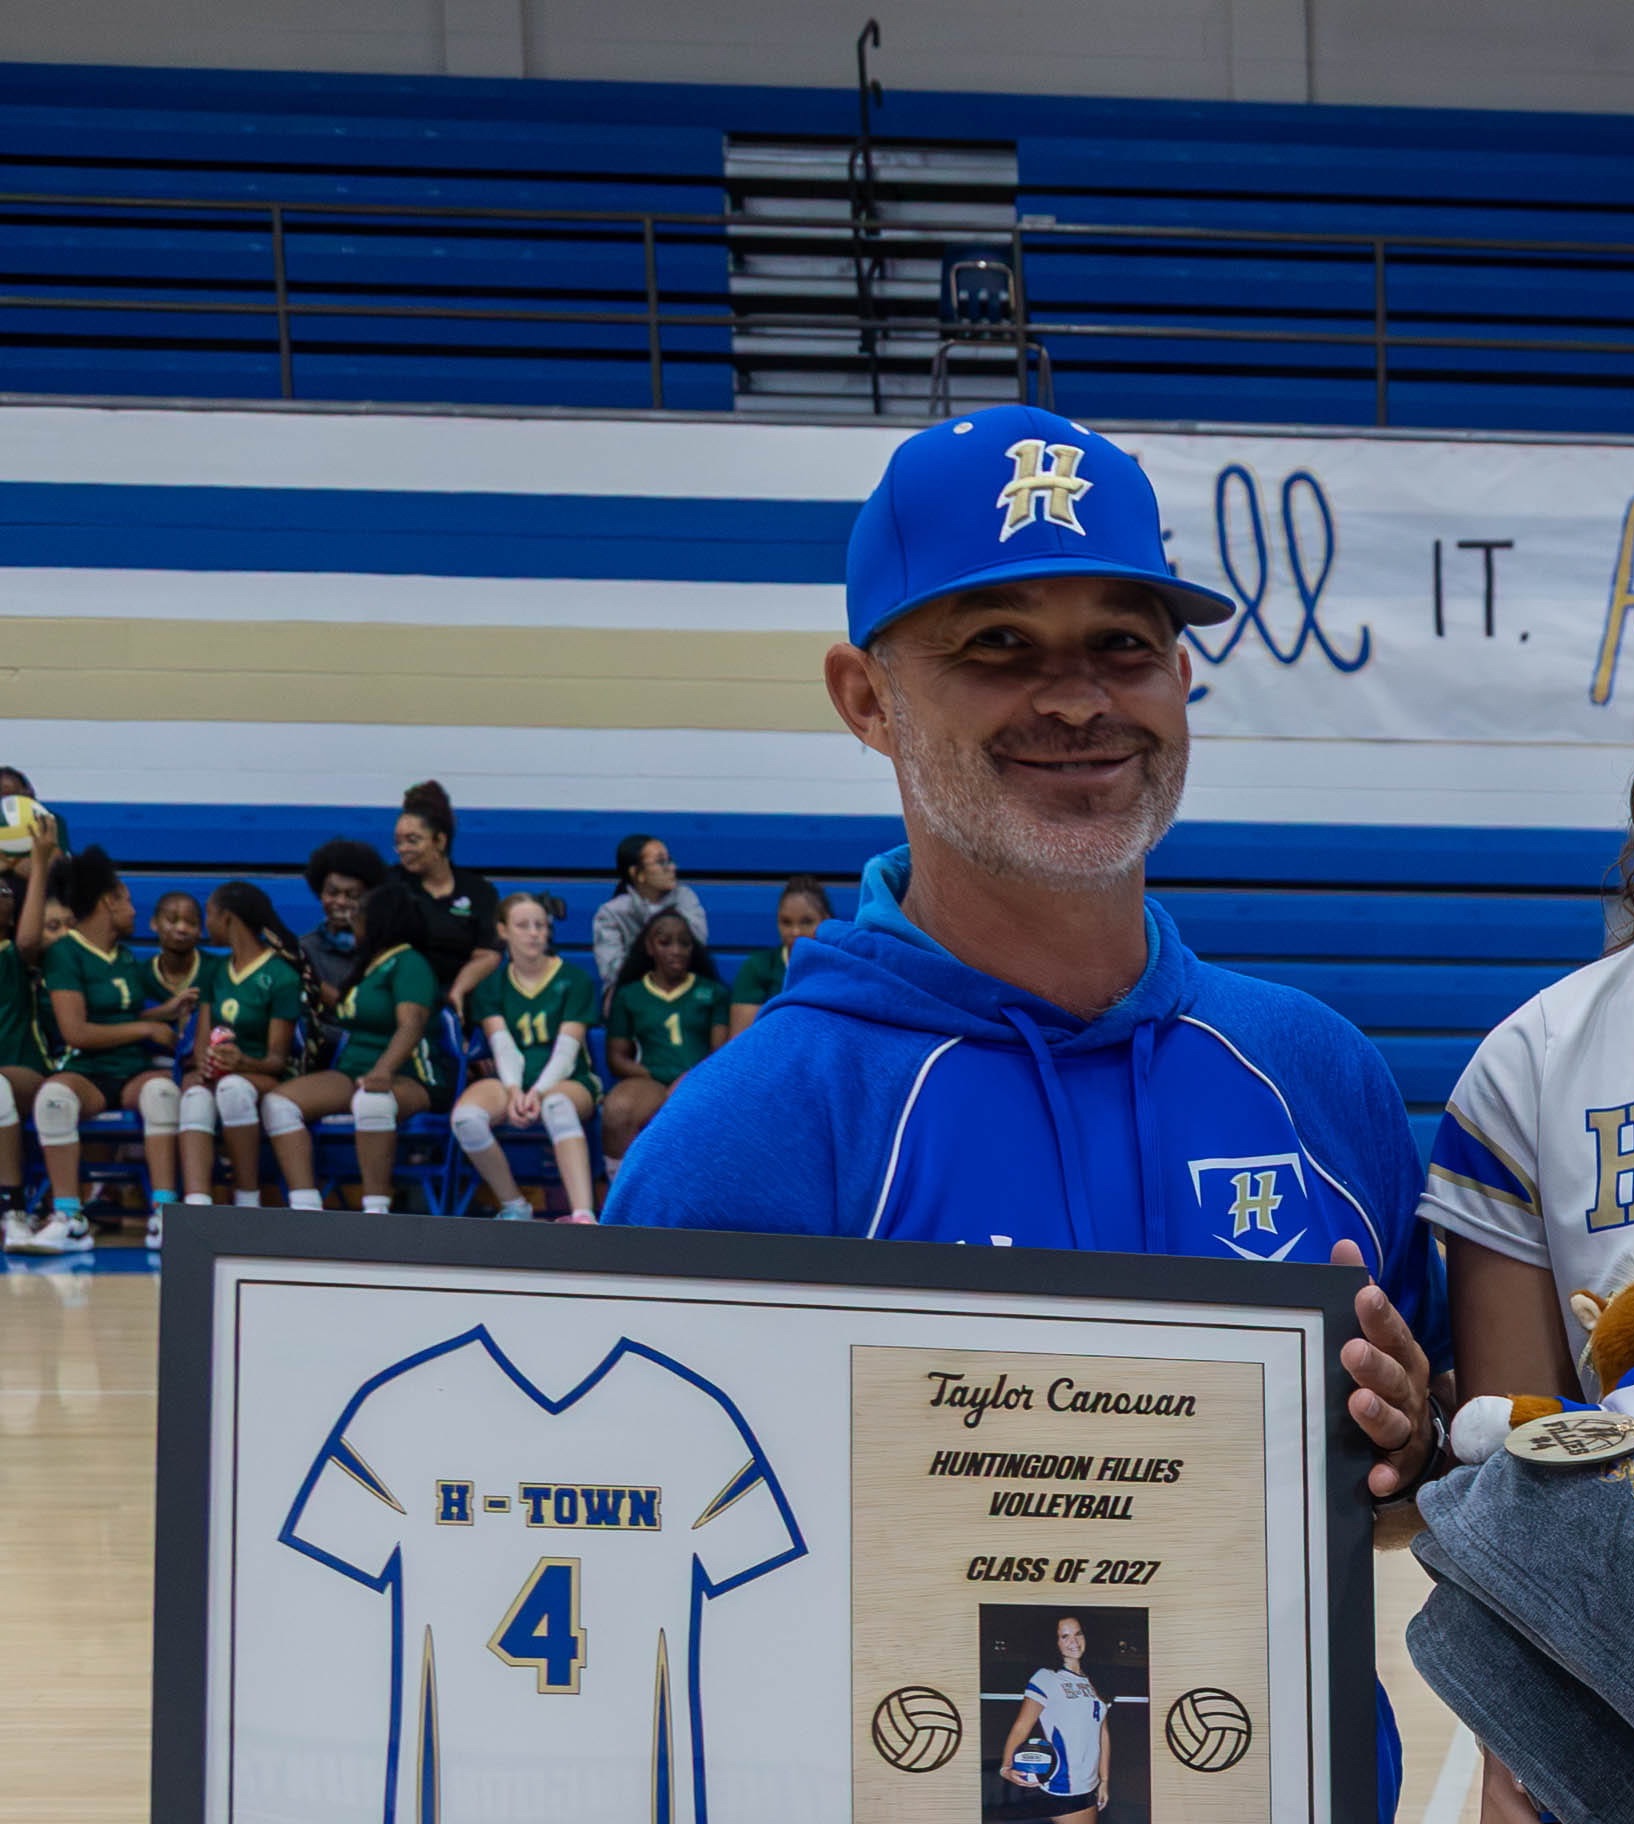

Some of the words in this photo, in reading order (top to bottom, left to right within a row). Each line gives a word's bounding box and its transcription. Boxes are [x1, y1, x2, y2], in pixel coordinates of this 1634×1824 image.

[996, 438, 1094, 543] H
[516, 1011, 549, 1047] 11
[663, 1012, 683, 1046] 1
[1228, 1170, 1283, 1239] H
[928, 1371, 1033, 1428] Taylor
[1047, 1377, 1196, 1417] Canovan
[1542, 1421, 1591, 1456] FILLIES
[928, 1450, 1095, 1481] HUNTINGDON
[1096, 1456, 1185, 1484] FILLIES
[988, 1491, 1134, 1520] VOLLEYBALL
[966, 1556, 1049, 1583] CLASS
[1053, 1558, 1090, 1584] OF
[1090, 1559, 1162, 1586] 2027
[487, 1556, 587, 1695] 4
